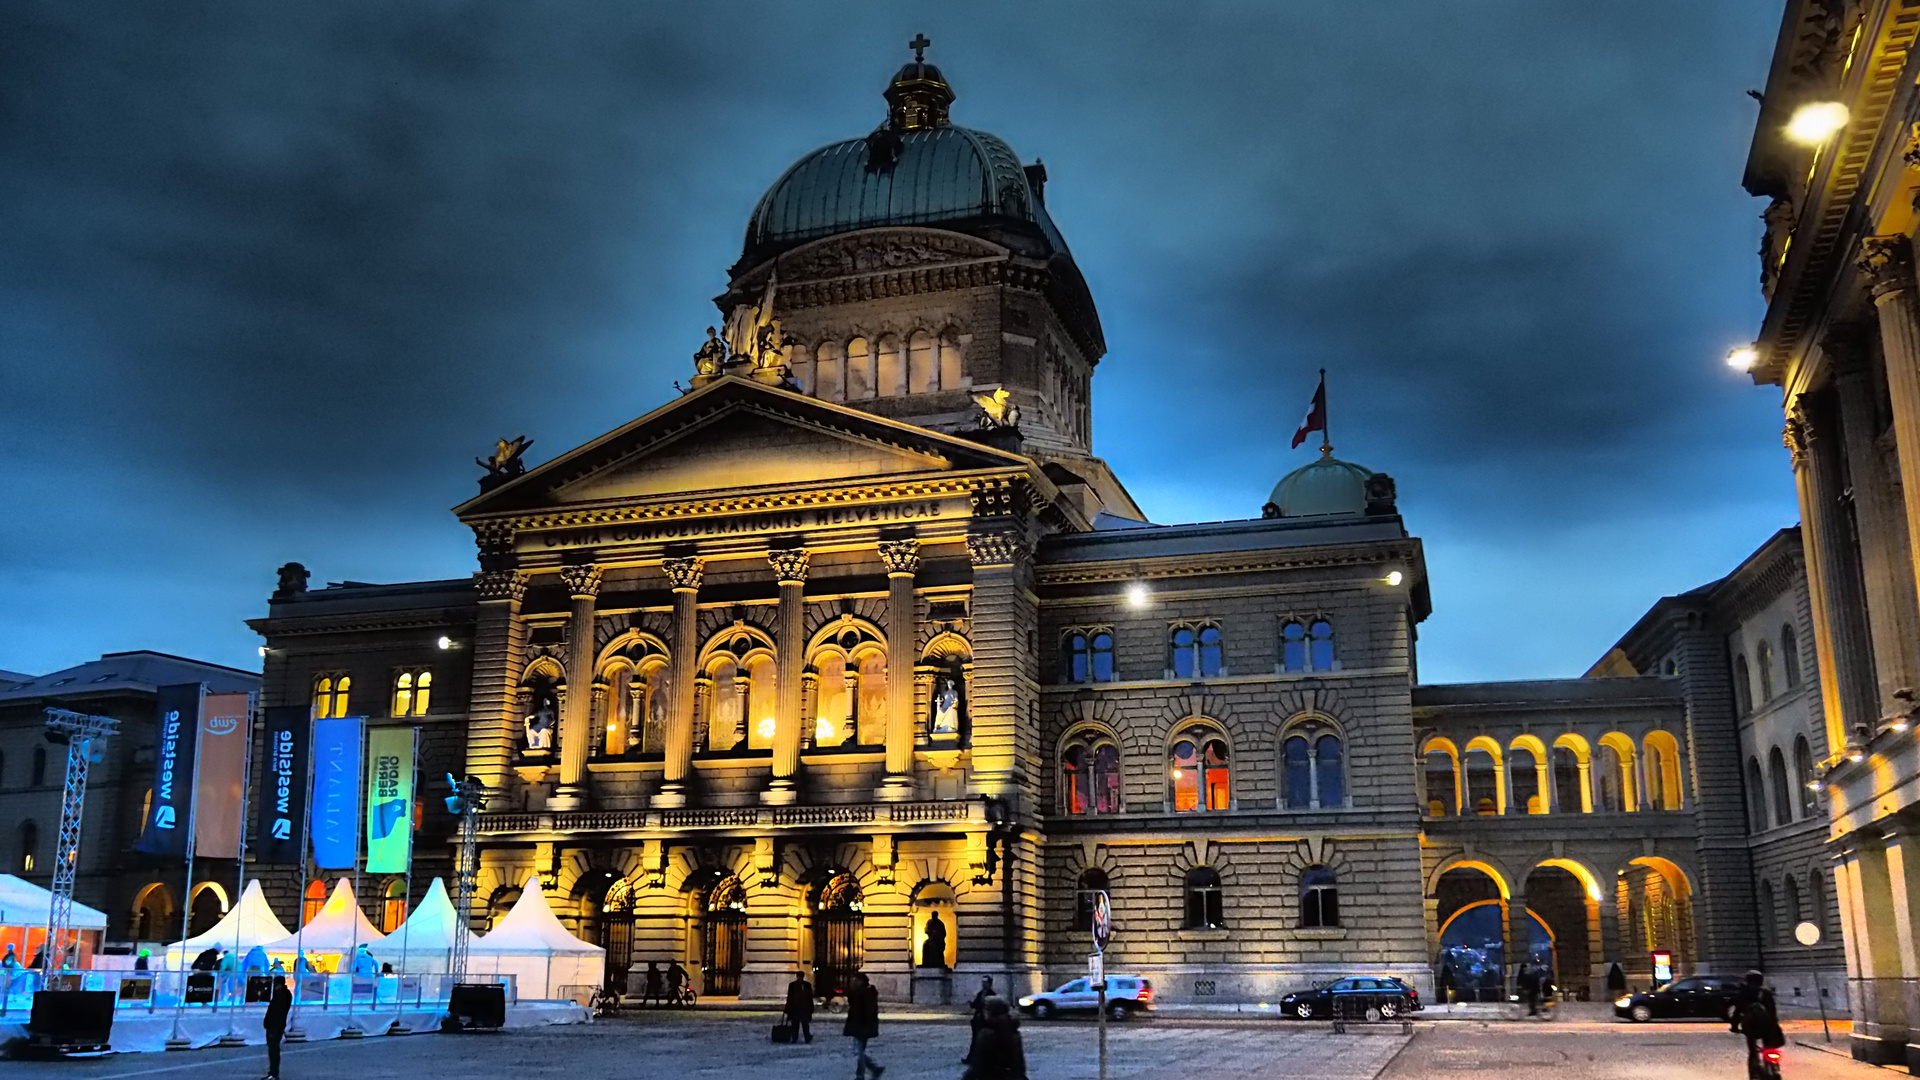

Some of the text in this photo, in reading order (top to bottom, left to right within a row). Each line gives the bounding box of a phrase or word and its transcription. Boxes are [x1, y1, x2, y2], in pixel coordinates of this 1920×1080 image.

[544, 503, 941, 548] CURIA CONFOEDERATIONIS HELVETICAE
